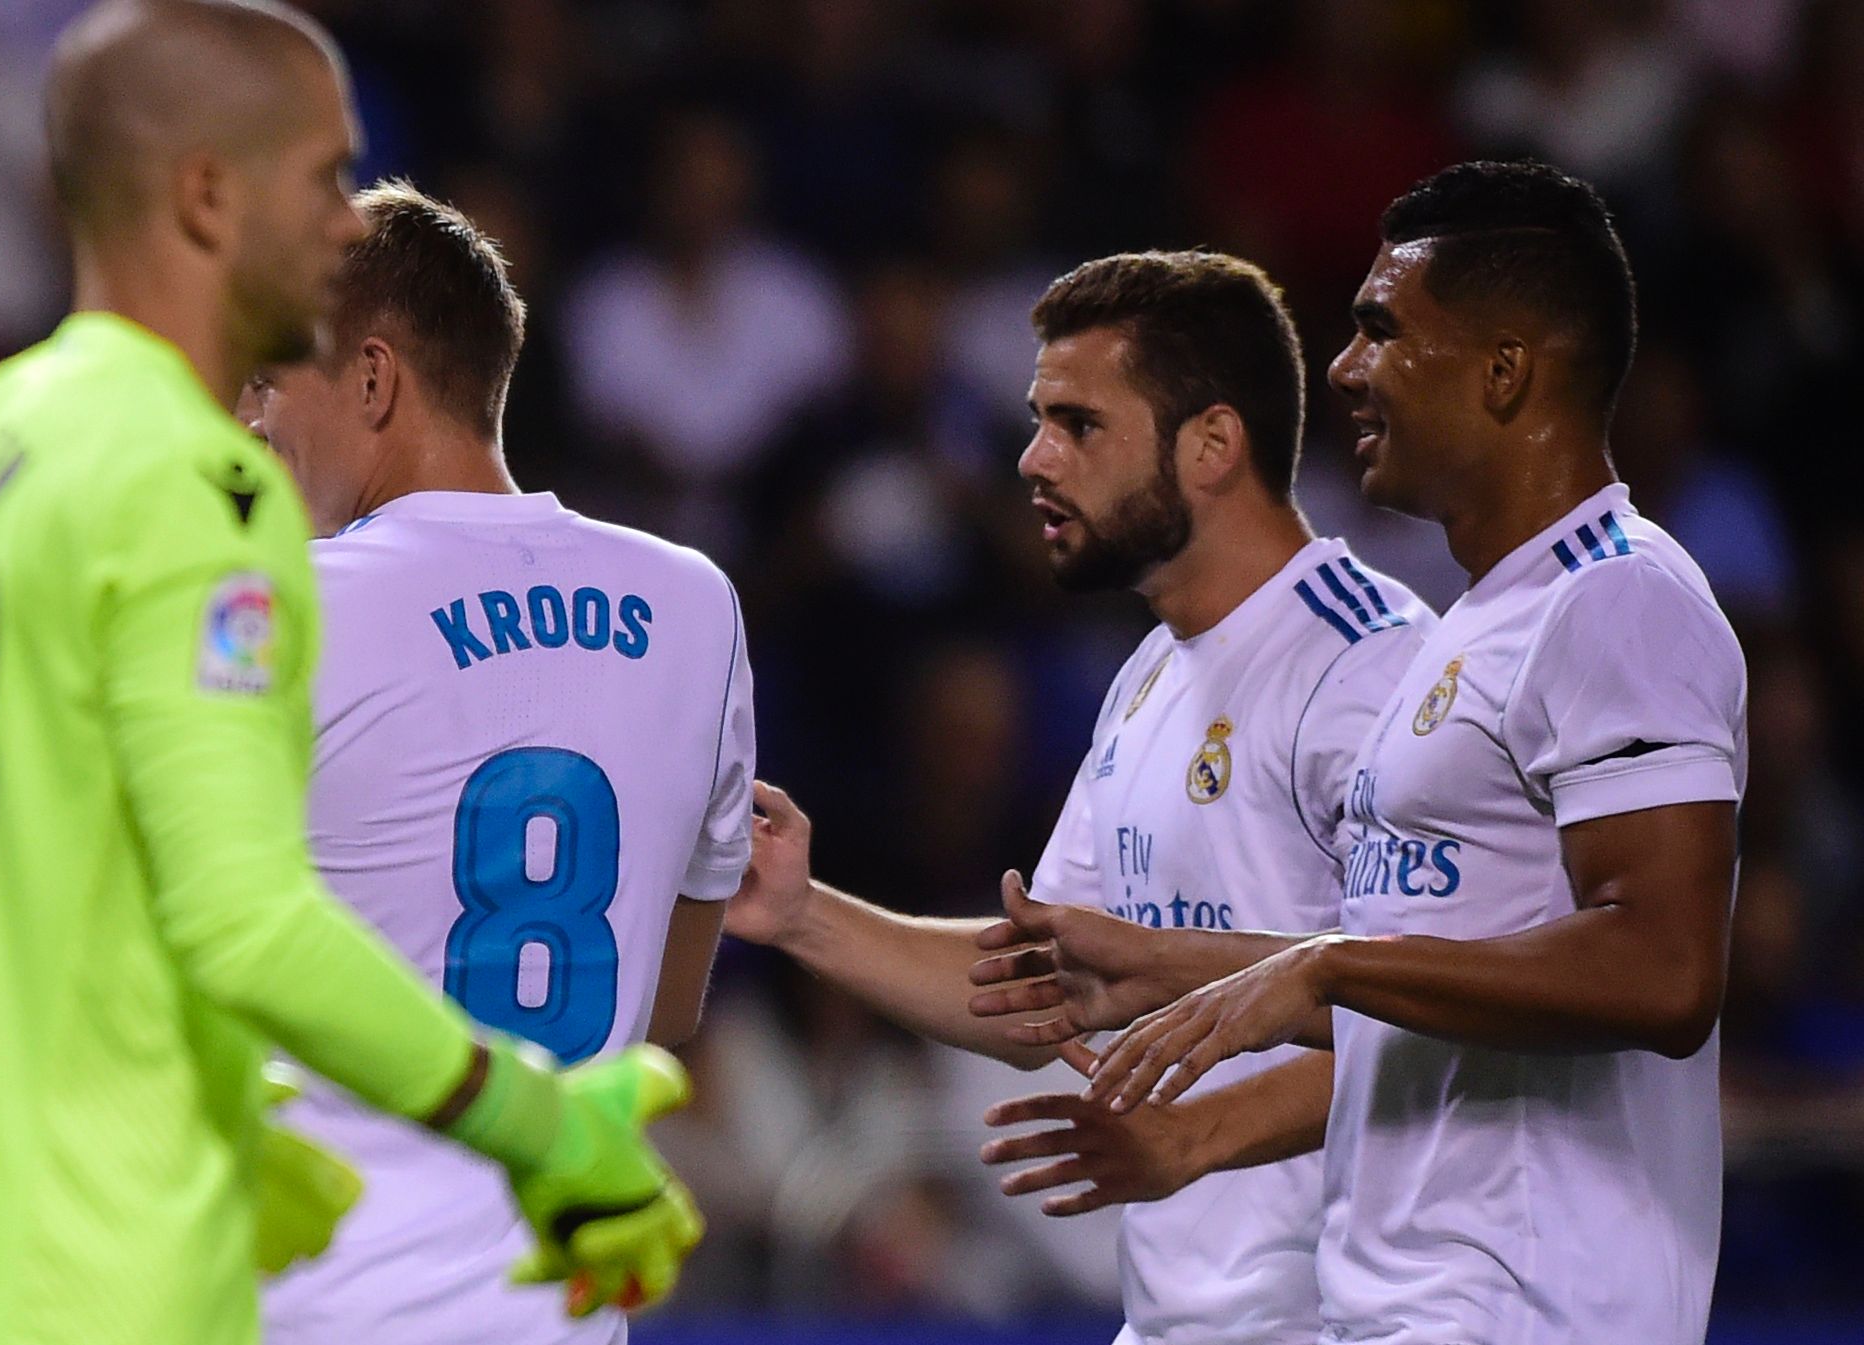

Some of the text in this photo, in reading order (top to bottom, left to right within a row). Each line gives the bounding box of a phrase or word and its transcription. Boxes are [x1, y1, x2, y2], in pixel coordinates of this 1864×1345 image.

[430, 584, 653, 670] KROOS
[1116, 826, 1153, 885] Fly
[443, 746, 620, 1068] 8
